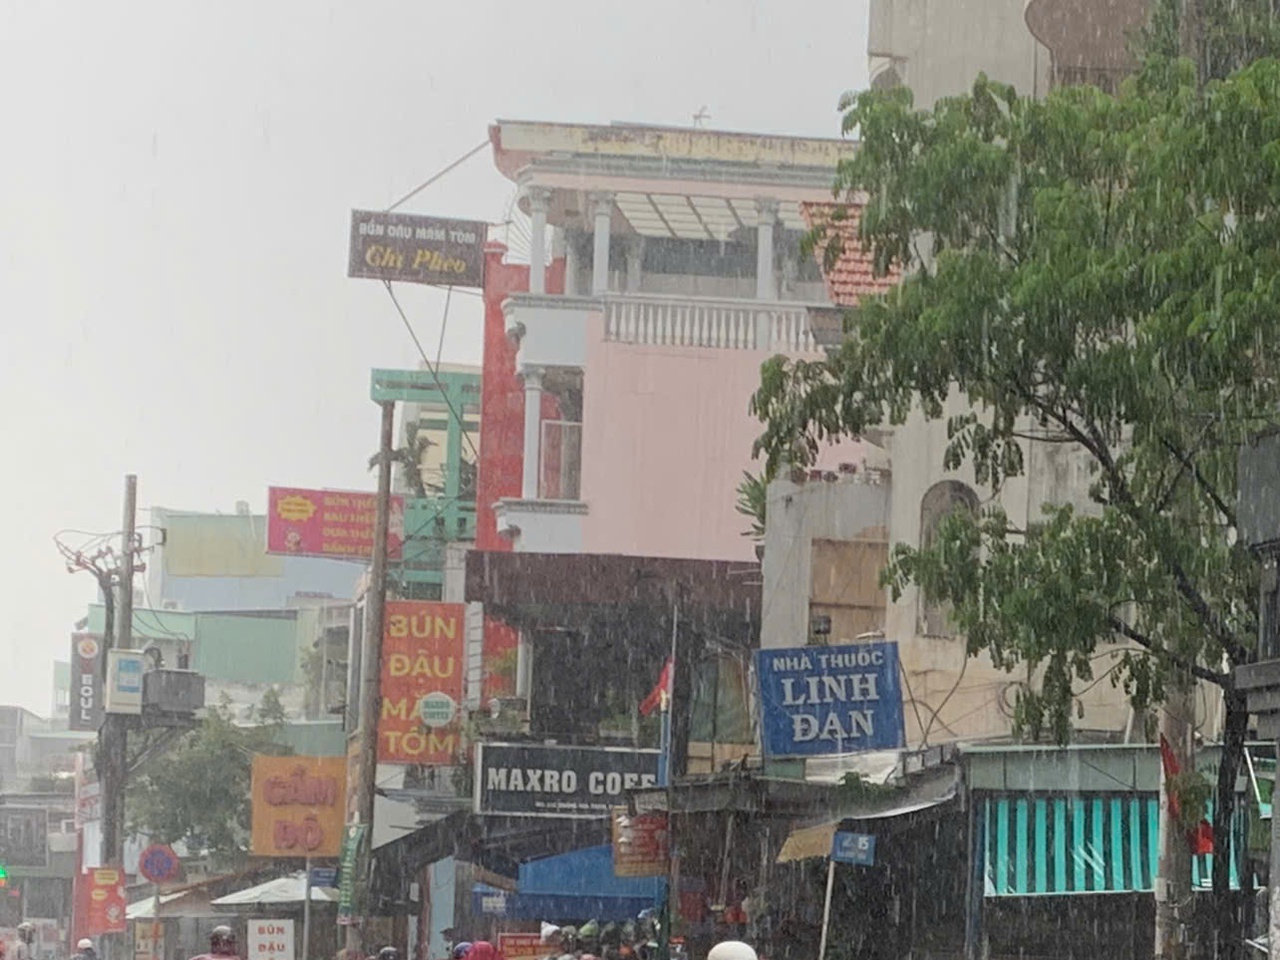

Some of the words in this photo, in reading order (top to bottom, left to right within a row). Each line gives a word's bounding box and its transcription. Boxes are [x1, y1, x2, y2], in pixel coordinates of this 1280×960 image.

[389, 610, 456, 639] BÚN
[773, 653, 812, 672] NHÀ
[781, 673, 880, 706] LINH
[792, 709, 875, 743] ĐAN
[487, 767, 578, 795] MAXRO
